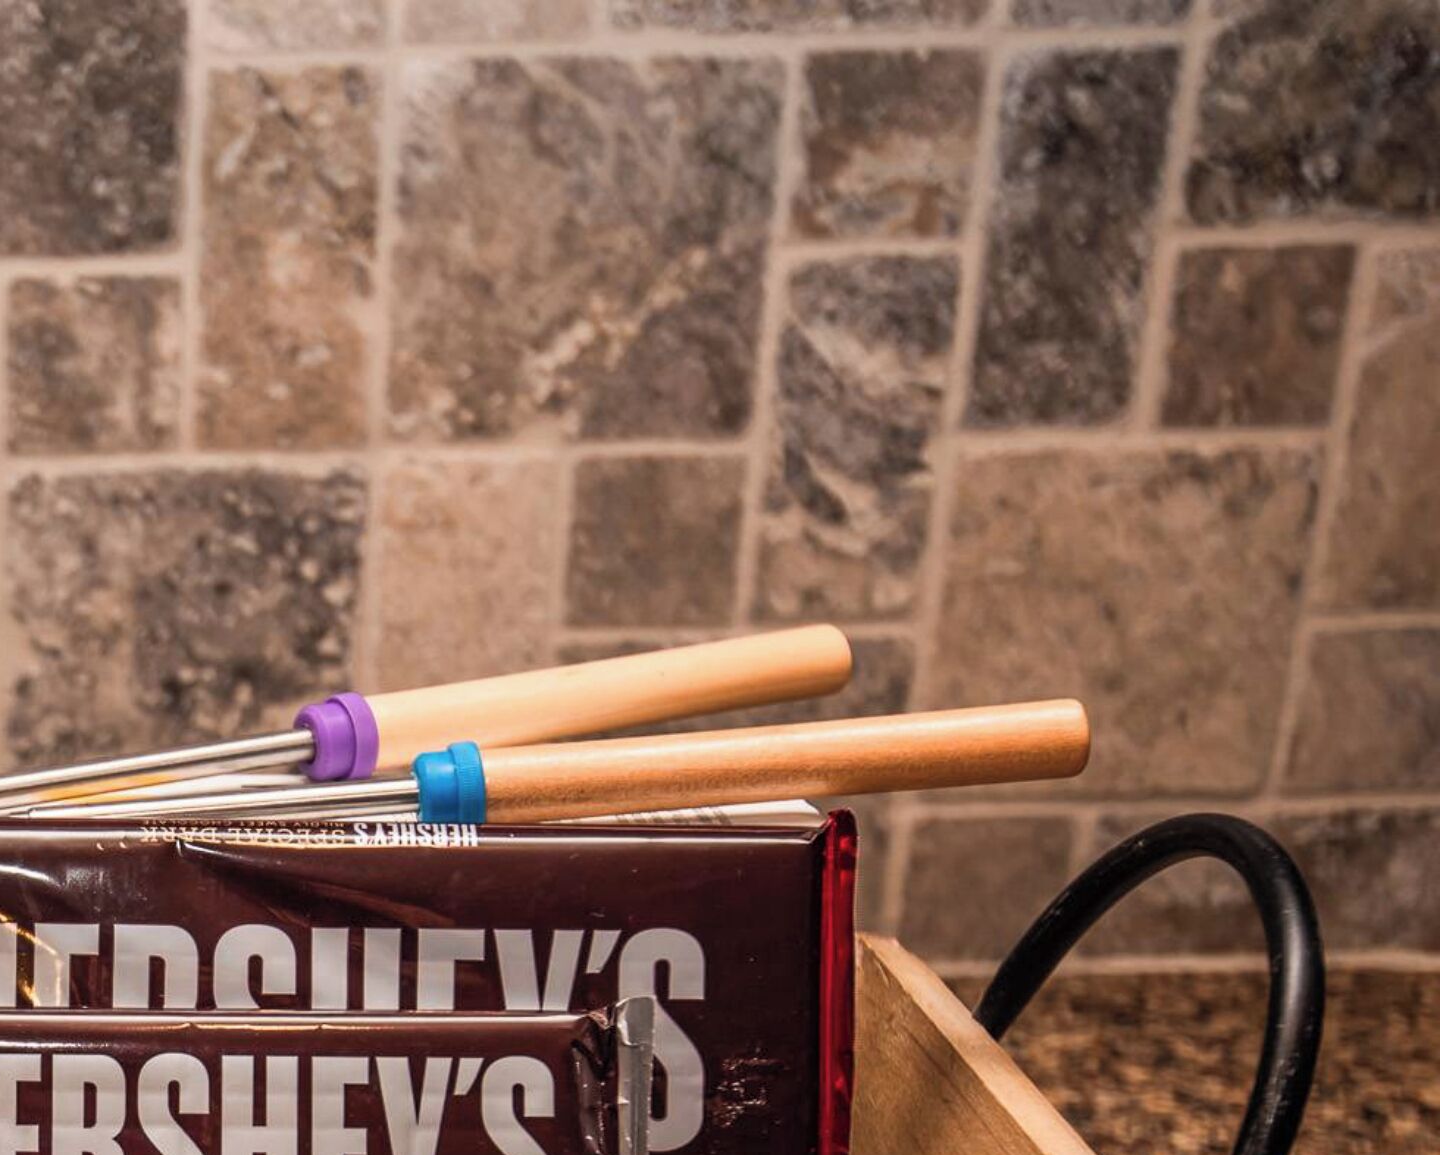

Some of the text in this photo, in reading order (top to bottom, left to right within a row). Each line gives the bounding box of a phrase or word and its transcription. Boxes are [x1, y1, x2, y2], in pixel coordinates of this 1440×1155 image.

[139, 822, 478, 849] HERSHEY'S SPECIAL DARK
